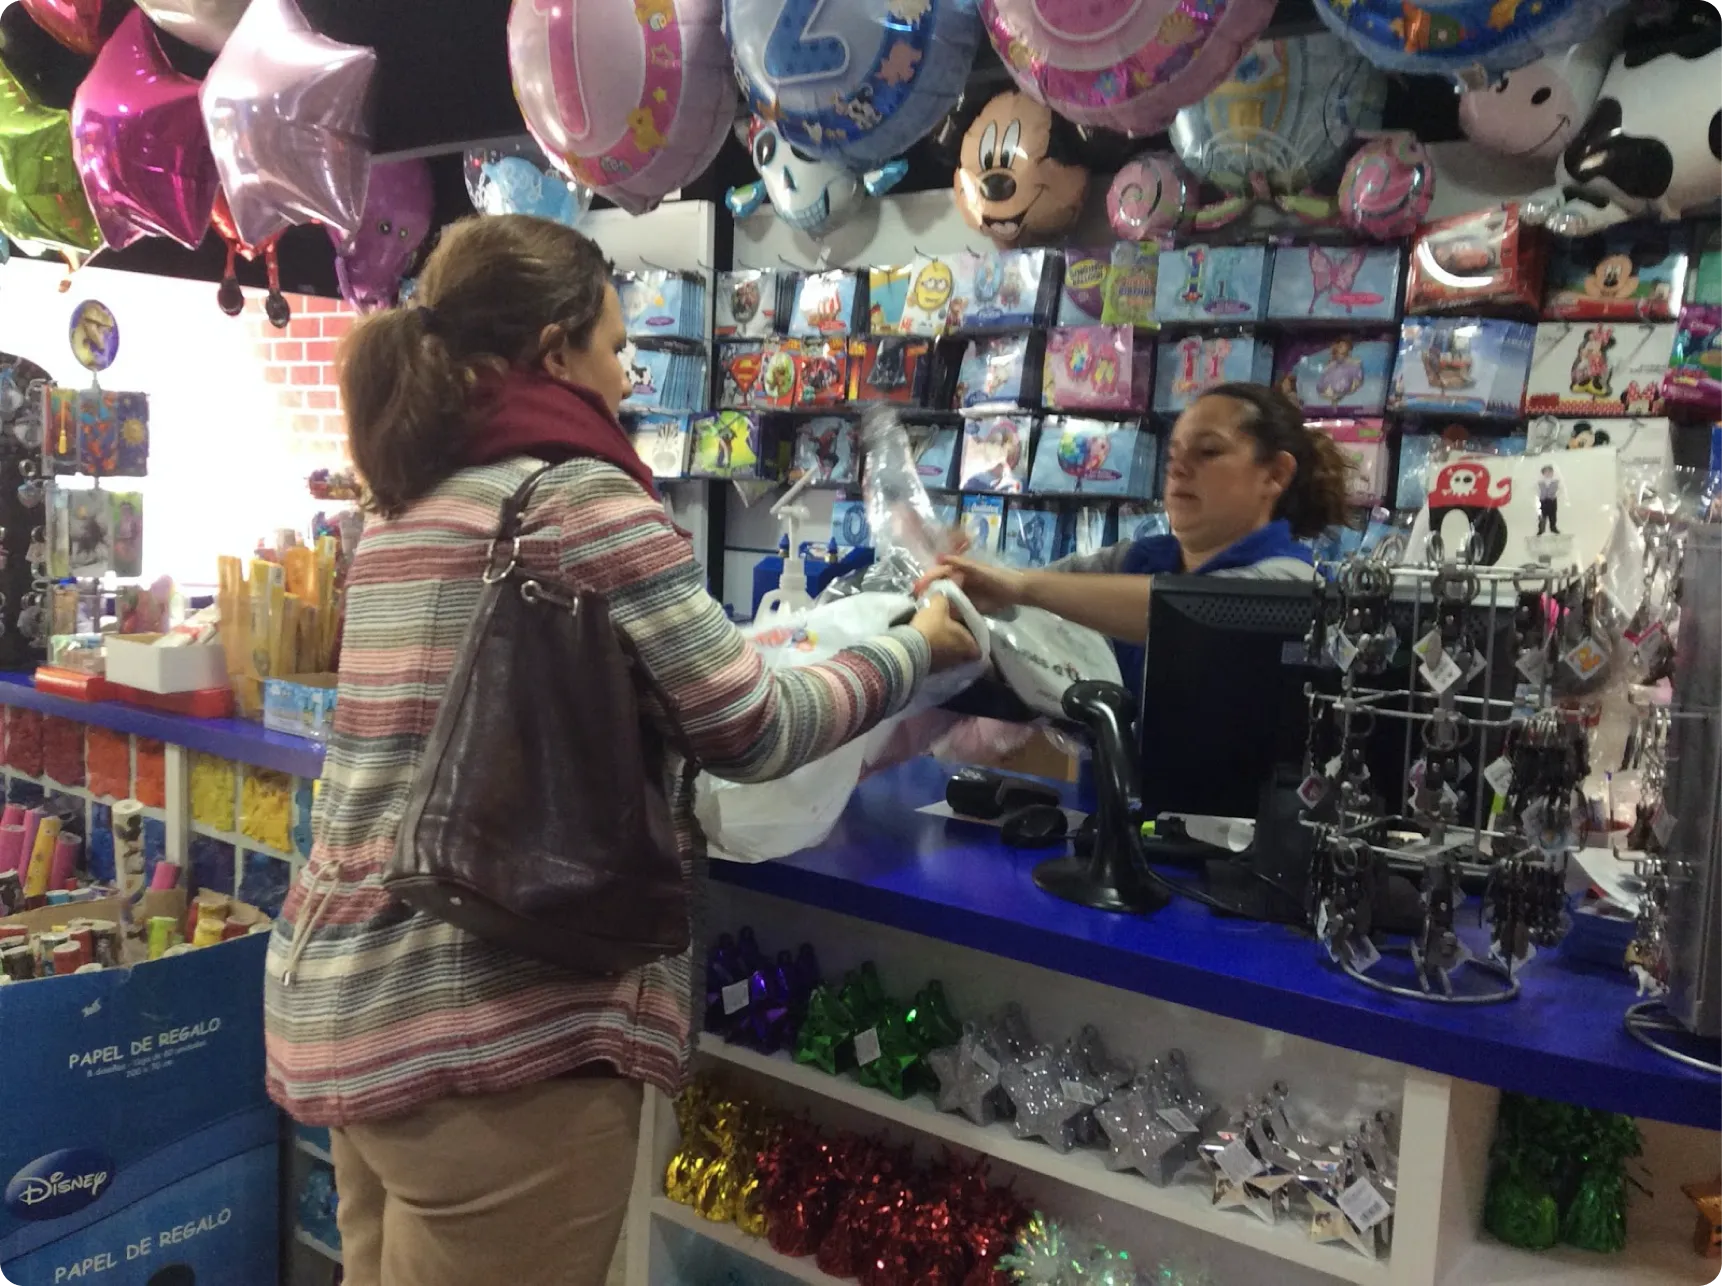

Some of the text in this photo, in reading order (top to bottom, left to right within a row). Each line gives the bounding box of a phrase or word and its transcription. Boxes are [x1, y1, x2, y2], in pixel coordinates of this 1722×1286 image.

[69, 1046, 124, 1069] PAPEL
[130, 1036, 154, 1055] DE
[158, 1017, 221, 1047] REGALO
[54, 1208, 232, 1284] PAPEL DE REGALO
